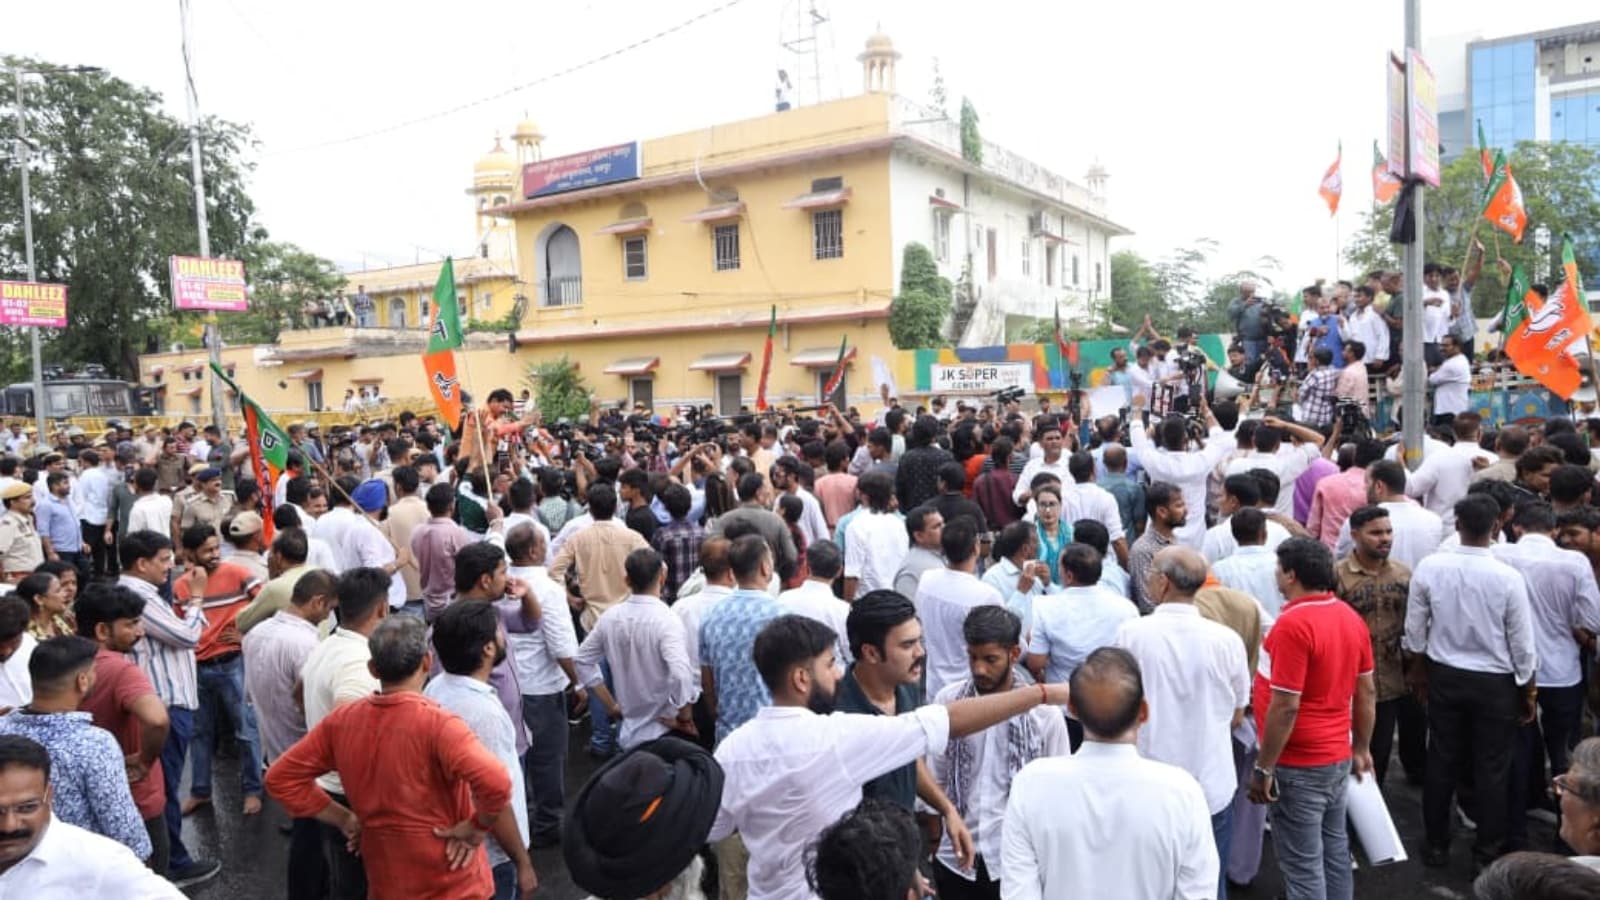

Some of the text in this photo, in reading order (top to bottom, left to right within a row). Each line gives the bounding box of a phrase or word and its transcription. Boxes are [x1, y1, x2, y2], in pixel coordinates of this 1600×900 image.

[177, 258, 243, 277] DAHLEEZ
[2, 284, 65, 301] DAHLEEZ
[940, 368, 955, 381] JK
